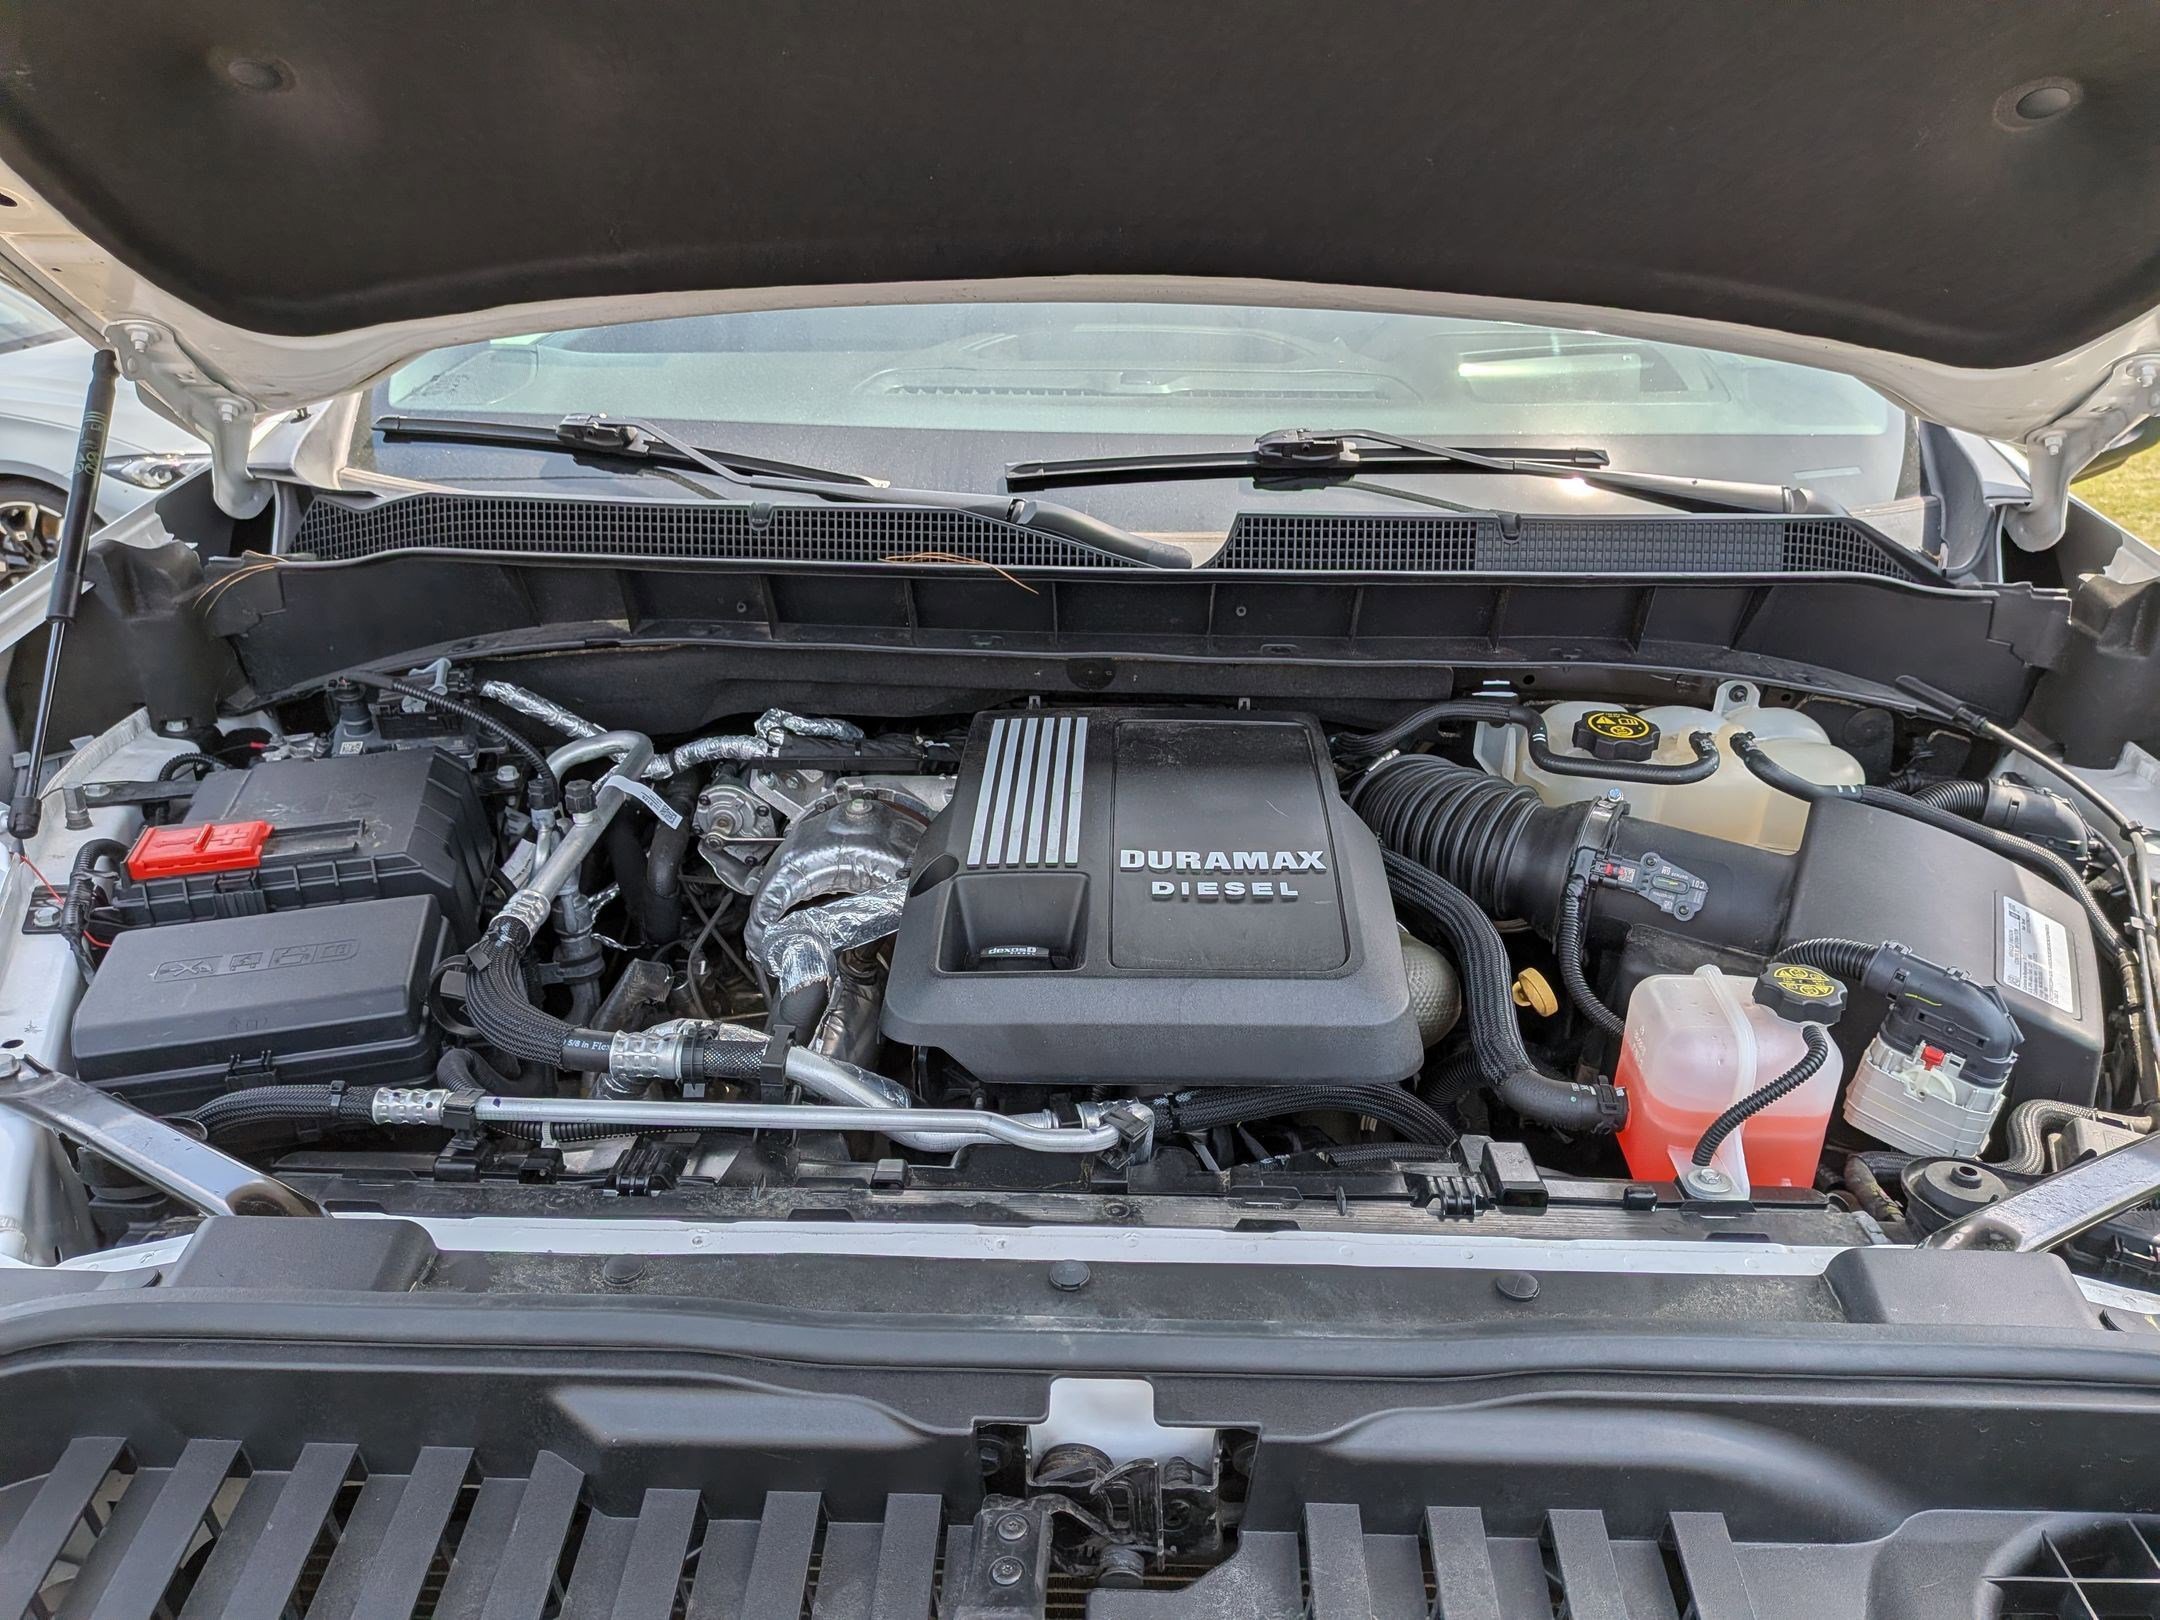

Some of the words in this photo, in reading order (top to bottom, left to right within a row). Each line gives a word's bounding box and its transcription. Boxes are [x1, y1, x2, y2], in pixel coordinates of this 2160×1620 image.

[1120, 849, 1327, 871] DURAMAX
[1151, 881, 1299, 897] DIESEL
[567, 1039, 581, 1048] 5/8
